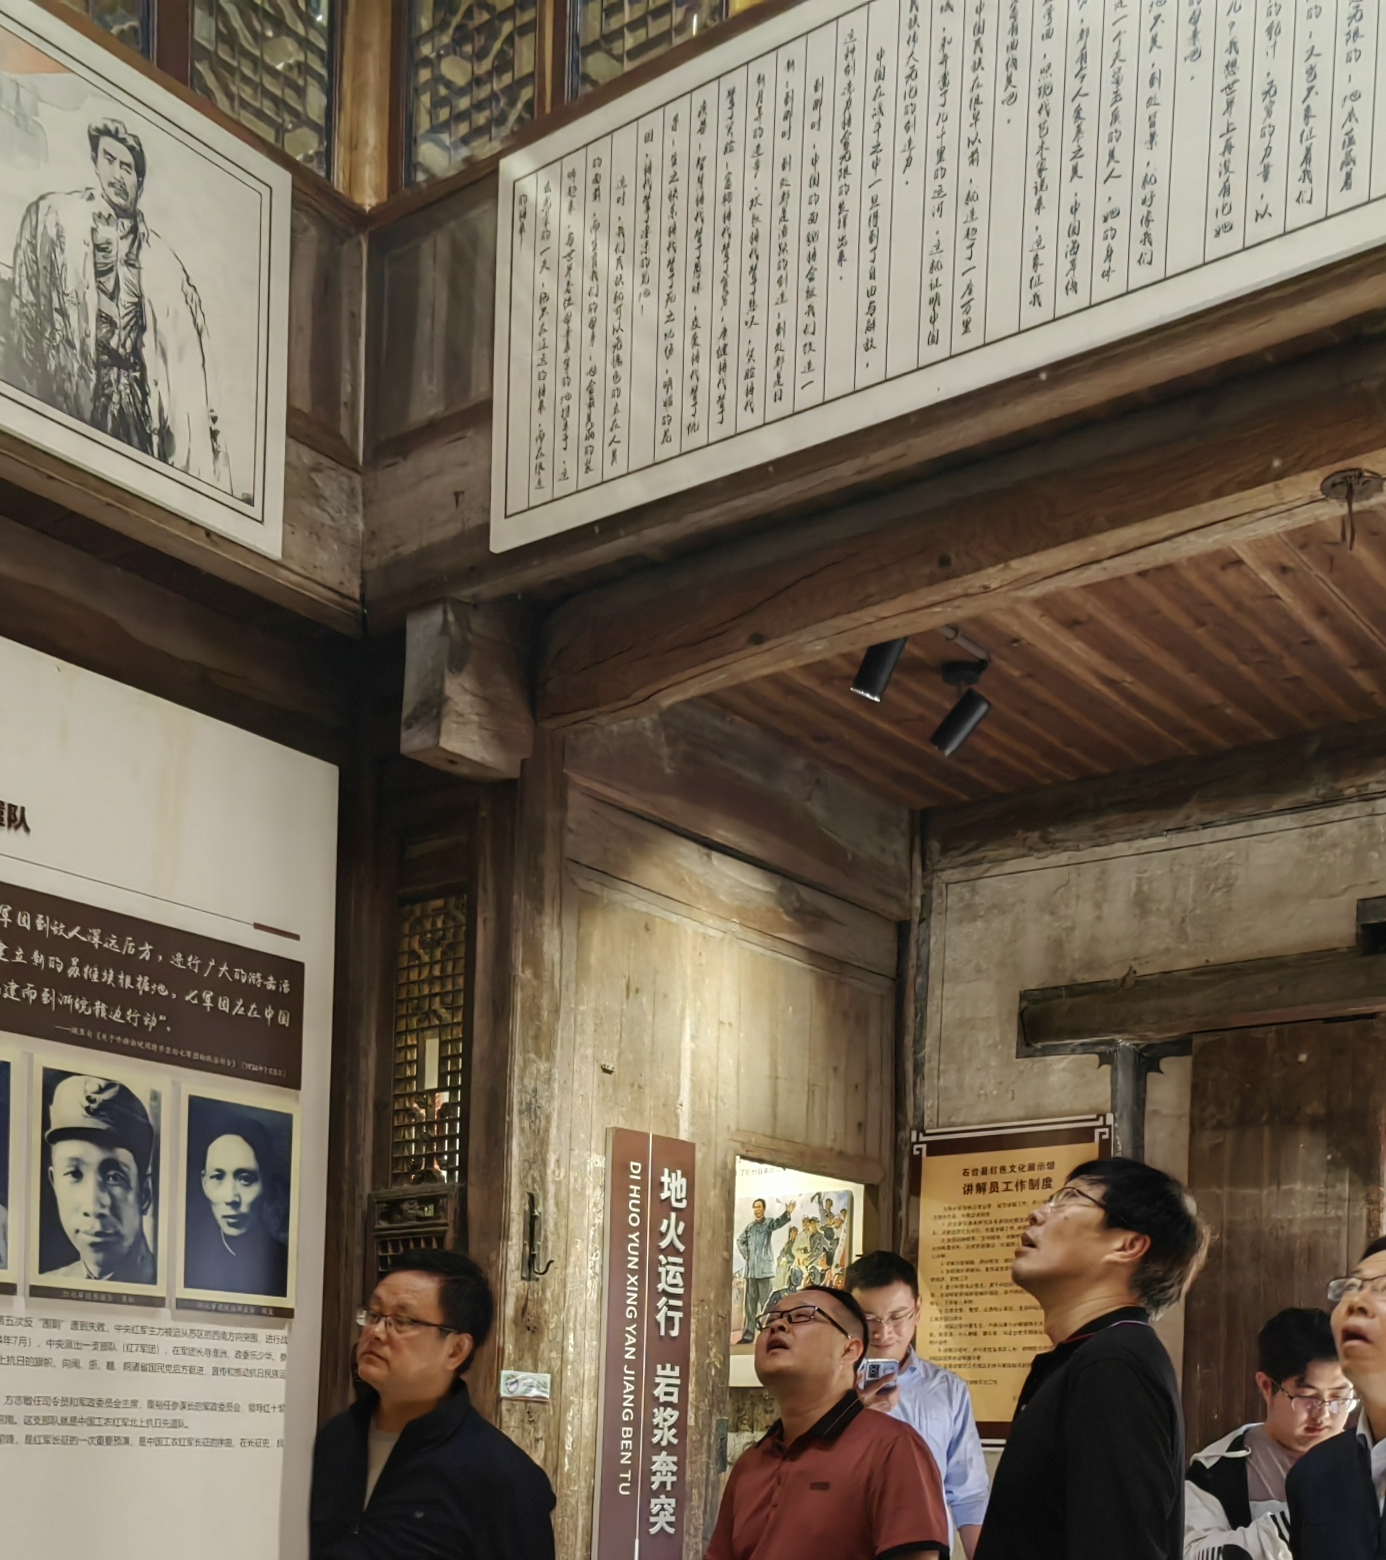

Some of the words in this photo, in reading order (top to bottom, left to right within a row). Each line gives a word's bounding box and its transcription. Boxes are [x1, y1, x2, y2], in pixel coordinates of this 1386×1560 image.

[629, 1161, 642, 1181] DI
[962, 1160, 1056, 1178] 石台县红色文化展示馆
[962, 1175, 1055, 1196] 讲解员工作制度
[628, 1189, 642, 1227] HUO
[627, 1231, 641, 1267] YUN
[655, 1166, 689, 1338] 地火运行
[625, 1274, 640, 1319] XING
[624, 1326, 638, 1361] YAN
[621, 1366, 637, 1422] JIANG
[620, 1427, 634, 1465] BEN
[647, 1362, 683, 1536] 岩浆奔突
[618, 1472, 632, 1495] TU
